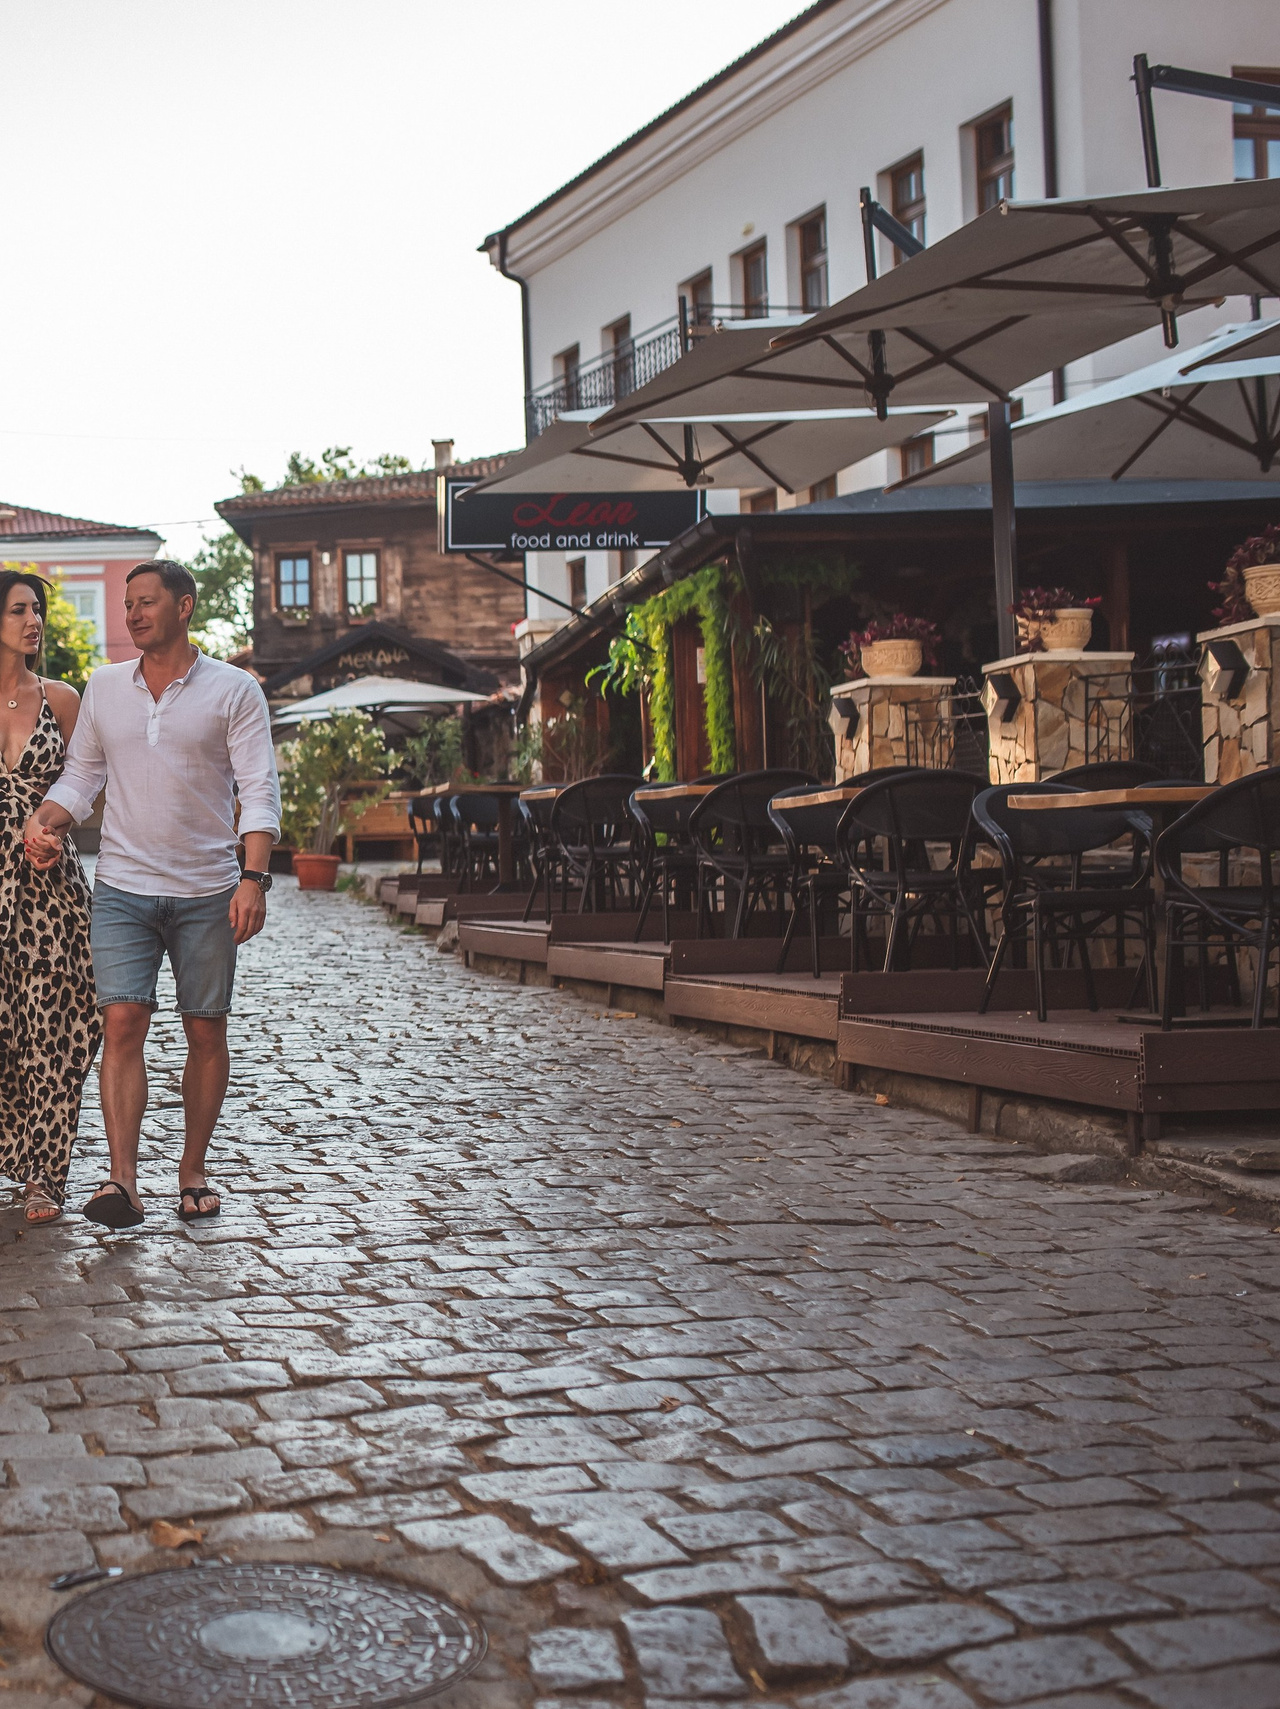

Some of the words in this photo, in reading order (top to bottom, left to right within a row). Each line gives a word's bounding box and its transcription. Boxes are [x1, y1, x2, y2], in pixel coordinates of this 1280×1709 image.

[512, 493, 638, 527] Leon
[511, 532, 551, 548] food
[556, 532, 591, 548] and
[596, 531, 640, 548] drink
